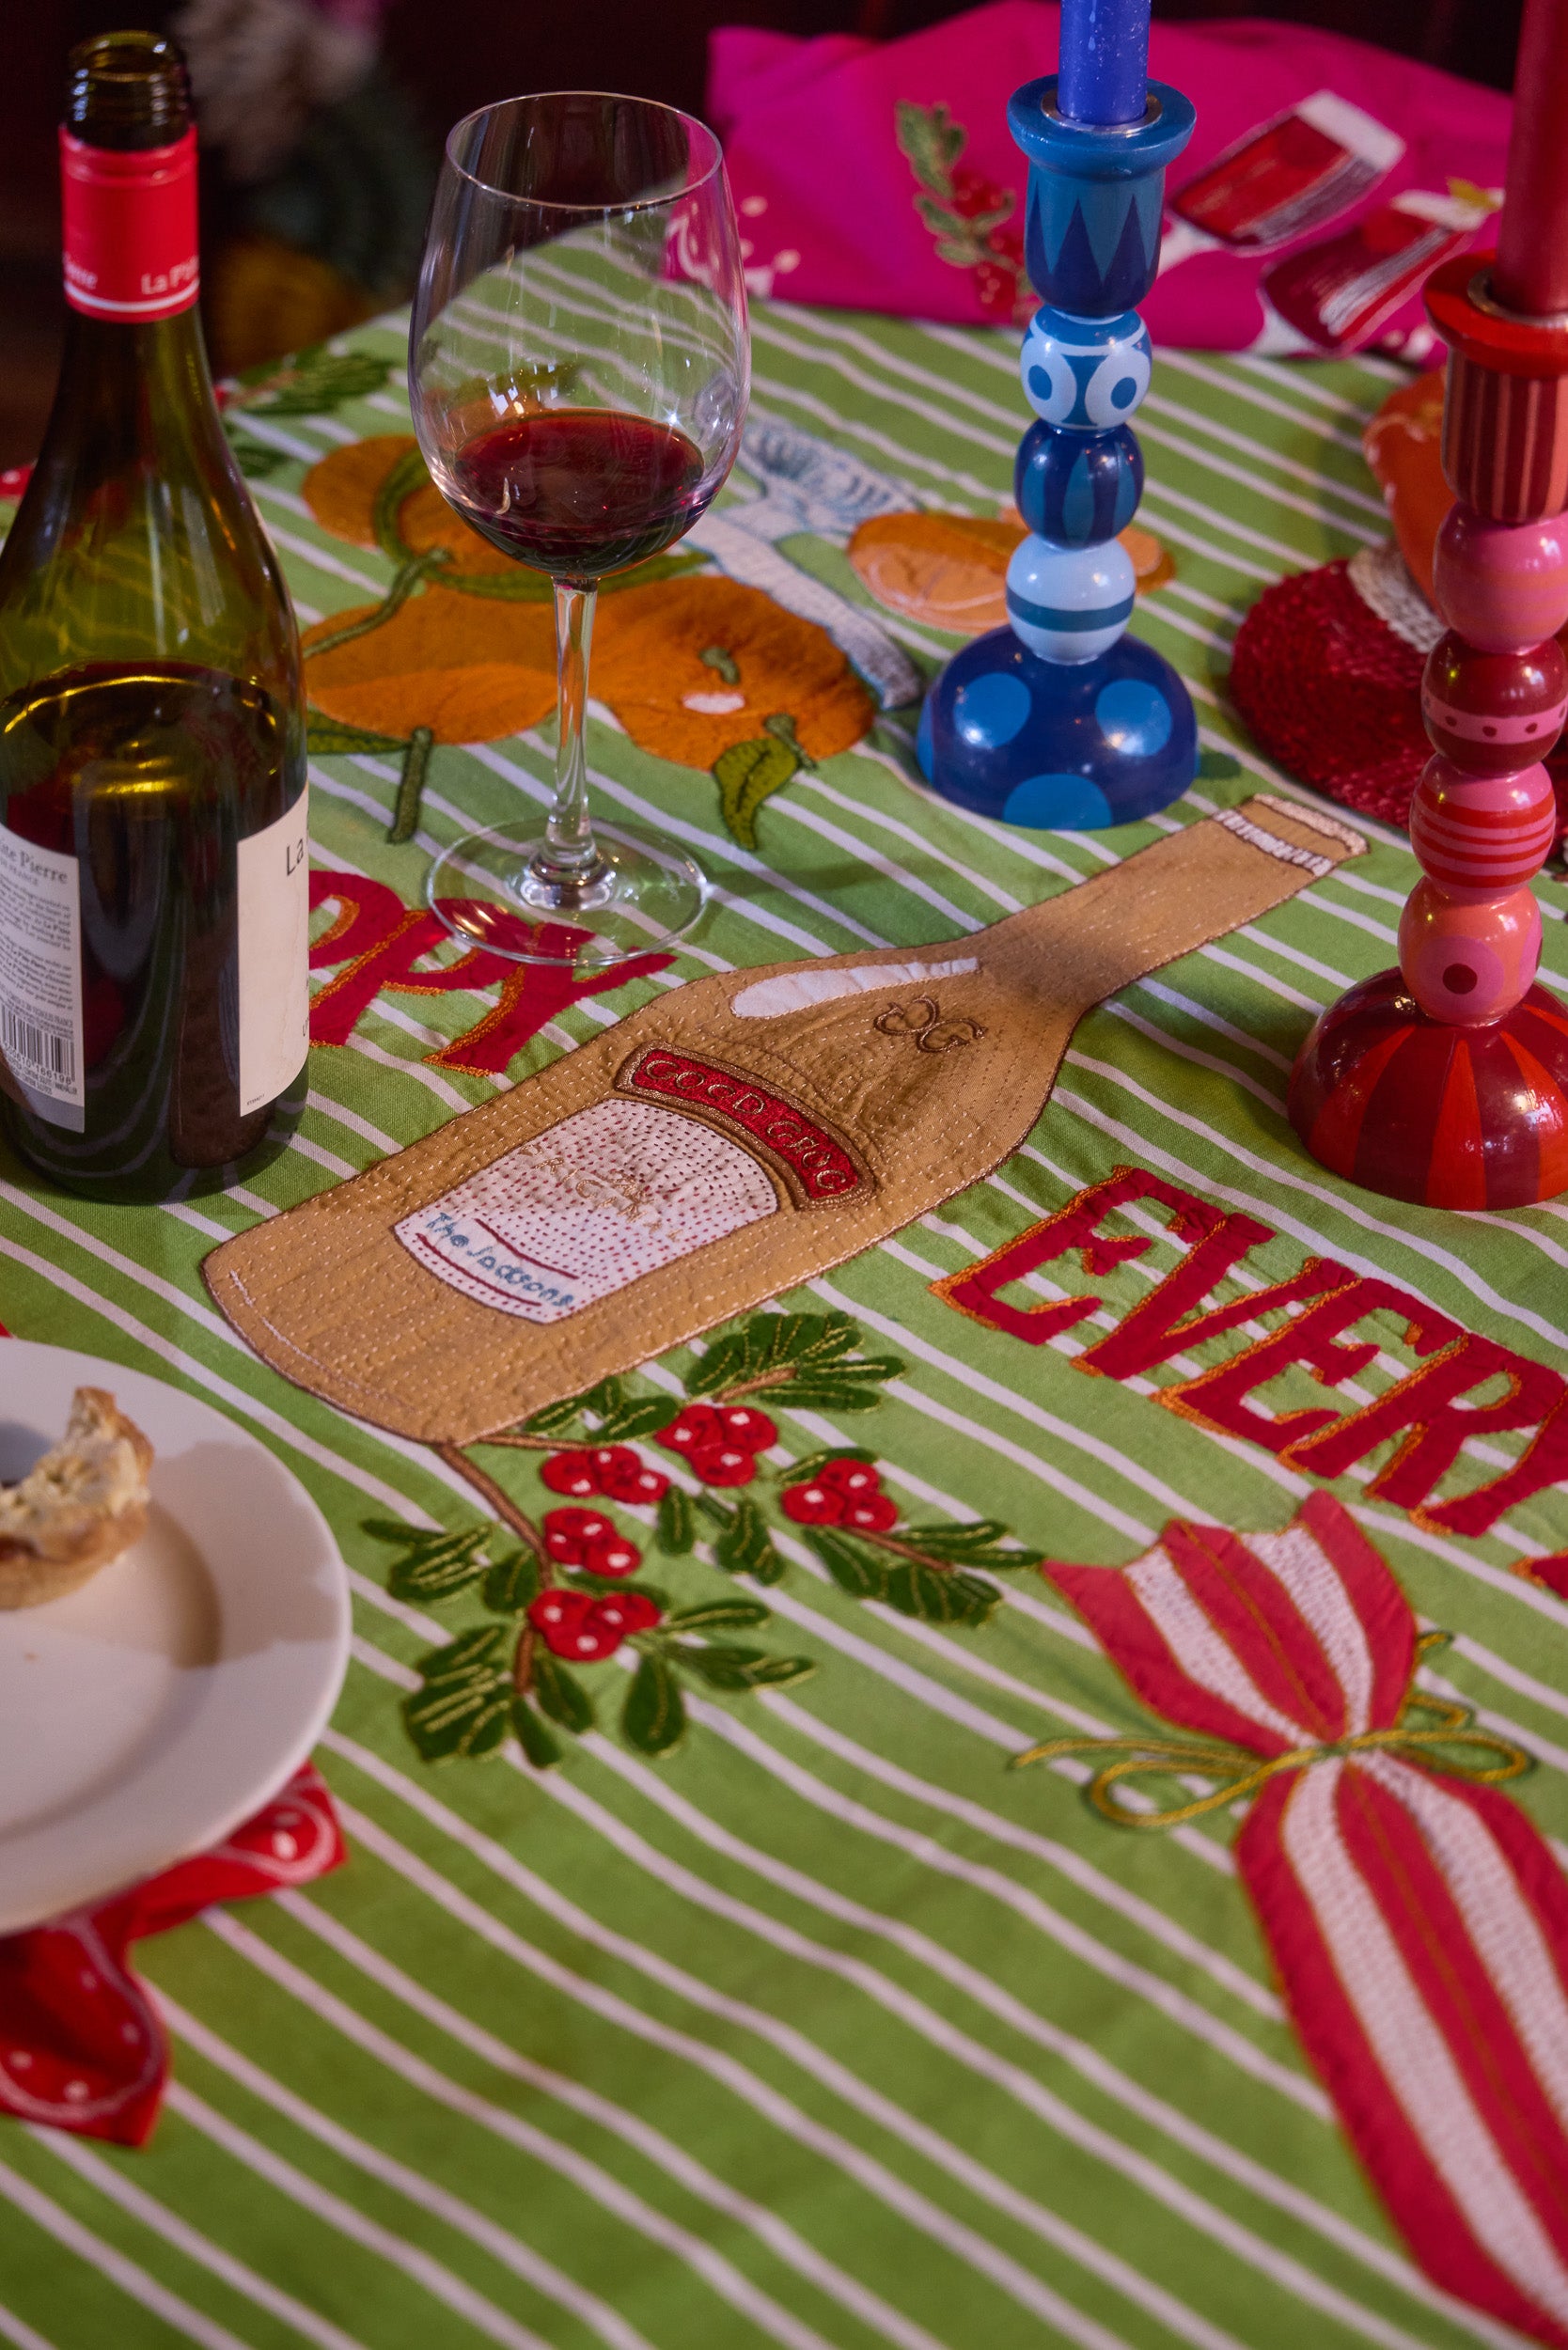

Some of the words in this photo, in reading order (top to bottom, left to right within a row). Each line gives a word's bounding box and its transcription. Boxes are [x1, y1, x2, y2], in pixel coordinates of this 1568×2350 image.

[20, 851, 68, 885] Pierre
[286, 838, 305, 876] La
[426, 1212, 470, 1247] The
